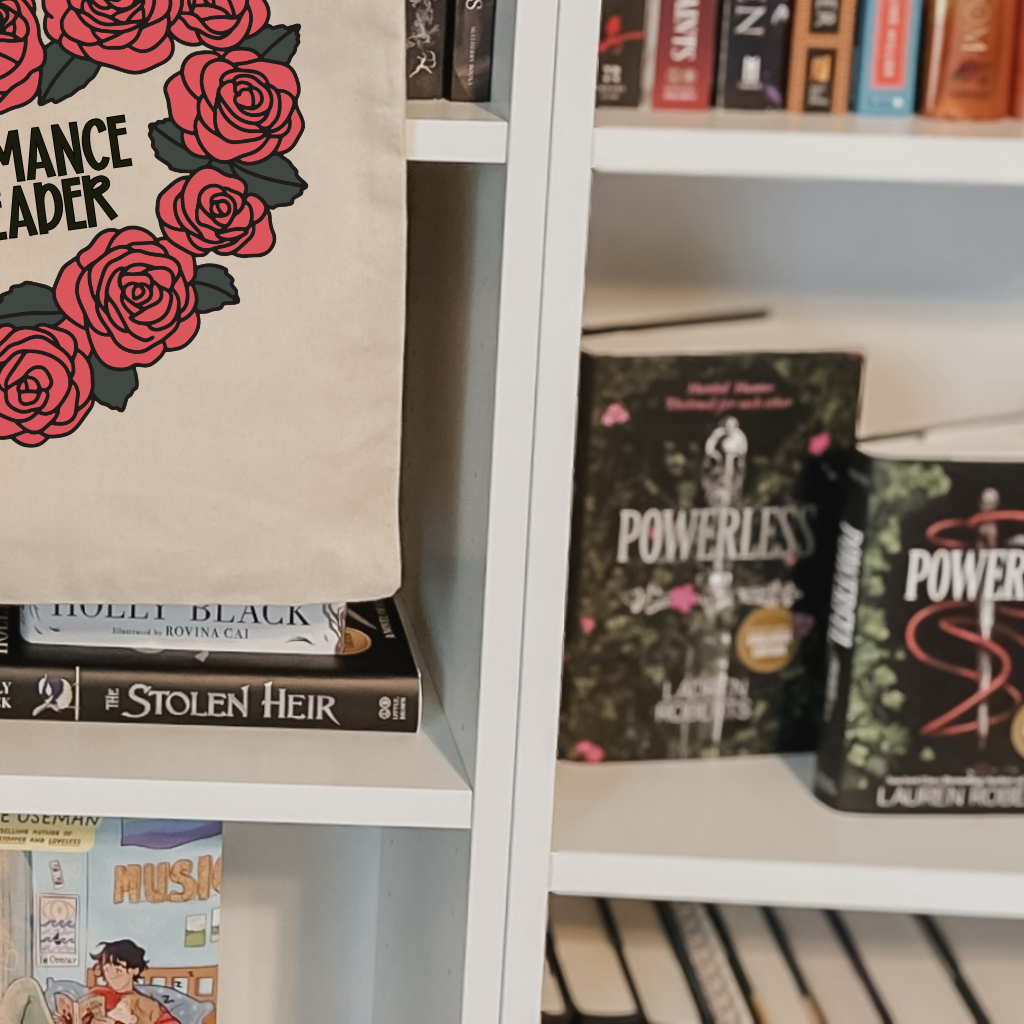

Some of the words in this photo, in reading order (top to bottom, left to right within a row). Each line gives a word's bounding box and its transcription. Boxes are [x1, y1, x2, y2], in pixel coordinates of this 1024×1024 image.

[617, 504, 818, 565] POWERLESS
[165, 626, 220, 638] ROVINA
[223, 628, 250, 639] CAI
[105, 687, 120, 710] THE
[121, 682, 250, 719] STOLEN
[261, 680, 341, 726] HEIR
